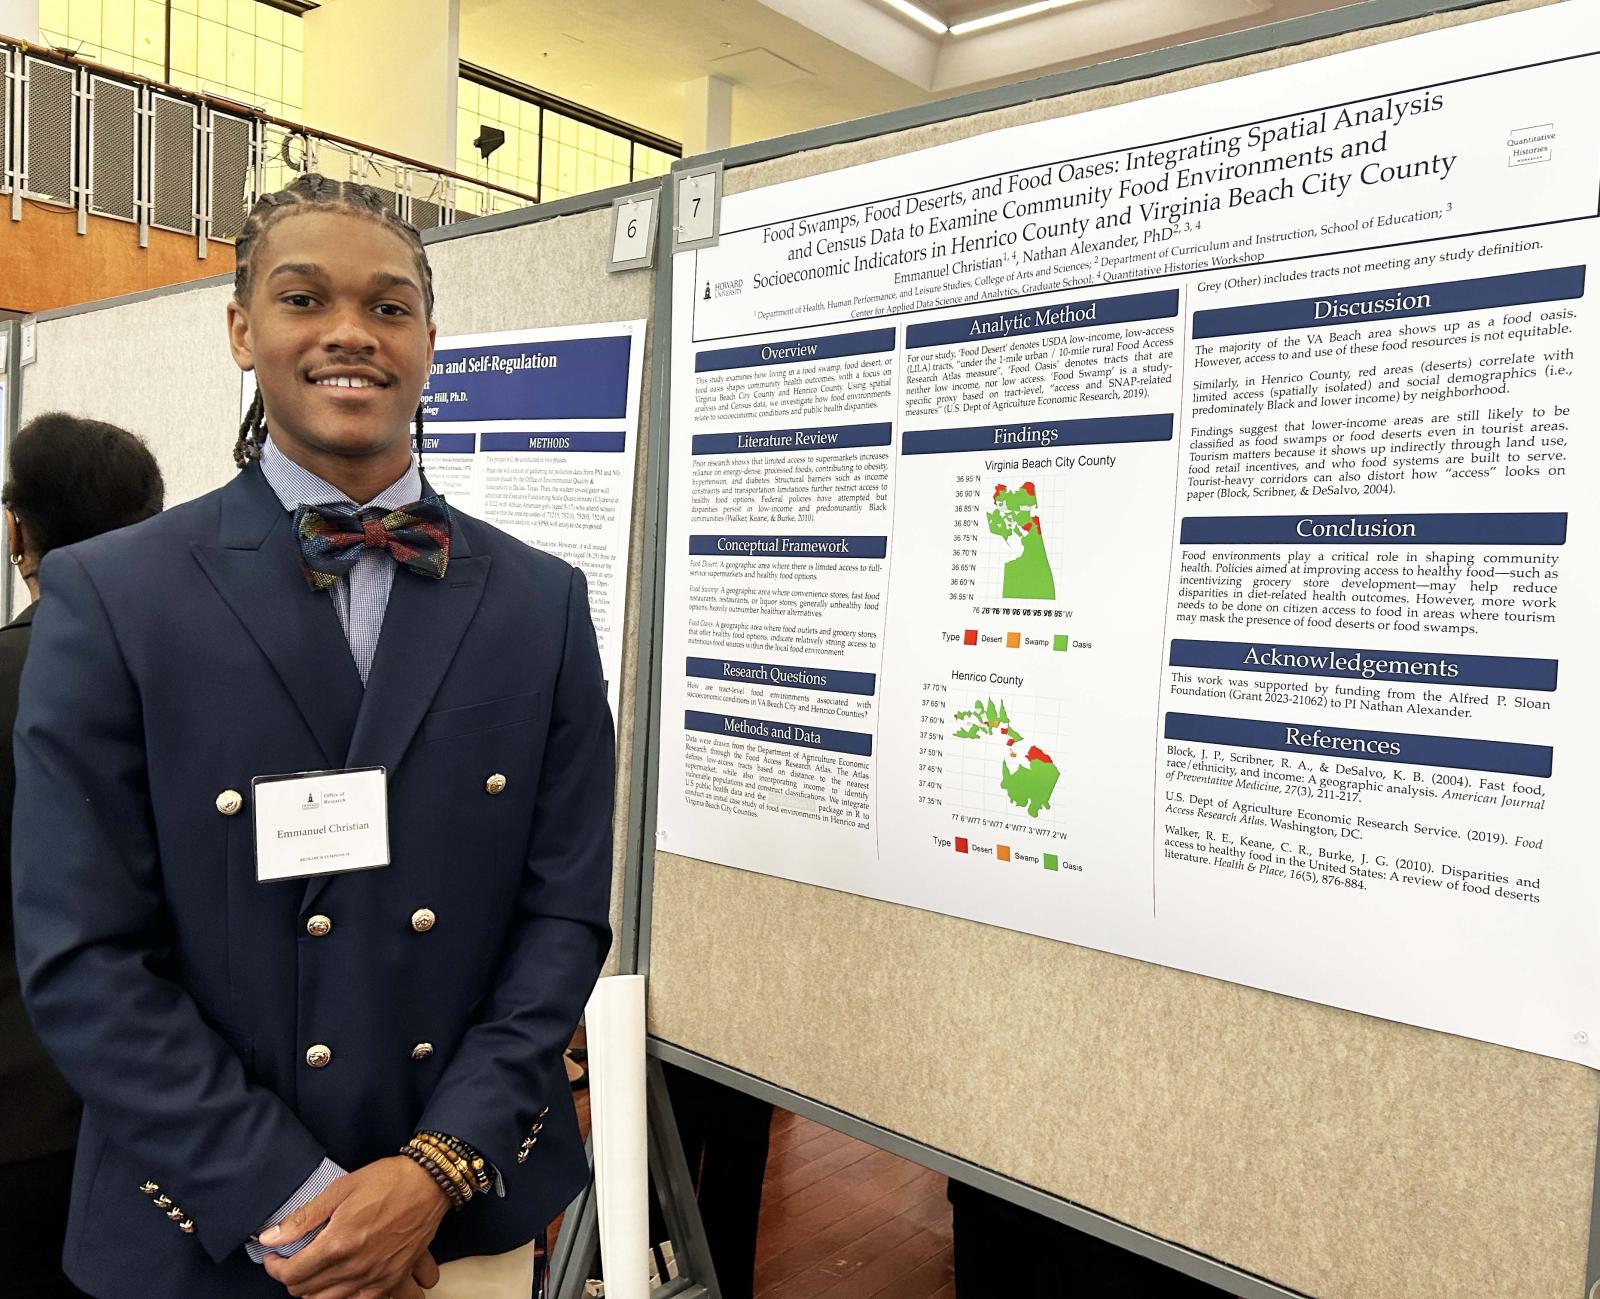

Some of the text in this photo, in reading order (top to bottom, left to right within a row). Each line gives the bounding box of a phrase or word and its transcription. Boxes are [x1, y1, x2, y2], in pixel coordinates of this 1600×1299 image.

[1506, 134, 1556, 146] Quantitative
[1514, 146, 1548, 157] Histories
[762, 92, 1443, 243] Food Swamps, Food Deserts, and Food Oases: Integrating Spatial Analysis
[787, 130, 1387, 260] and Census Data to Examine Community Food Environments and
[692, 198, 701, 218] 7
[627, 219, 637, 238] 6
[753, 154, 1457, 289] Socioeconomic Indicators in Henrico County and Virginia Beach City County
[894, 263, 949, 284] Emmanuel
[1022, 245, 1066, 263] Nathan
[1070, 234, 1138, 256] Alexander,
[1197, 240, 1543, 293] Grey (Other) includes tracts not meeting any study definition.
[714, 279, 743, 292] HOWARD
[1314, 294, 1431, 319] Discussion
[968, 304, 1096, 335] Analytic Method
[1194, 307, 1576, 355] The majority of the VA Beach area shows up as a food oasis.
[761, 343, 818, 360] Overview
[446, 358, 466, 373] and
[468, 353, 557, 376] Self-Regulation
[434, 393, 449, 403] Hill,
[450, 392, 468, 401] Ph.D.
[962, 403, 981, 413] Dept
[982, 400, 990, 410] of
[991, 398, 1036, 411] Agriculture
[1037, 393, 1077, 405] Economic
[1079, 390, 1120, 402] Research,
[1122, 387, 1149, 398] 2019).
[529, 438, 569, 449] METHODS
[737, 430, 838, 448] Literature Review
[993, 426, 1058, 445] Findings
[984, 455, 1116, 472] Virginia Beach City County
[1296, 518, 1416, 537] Conclusion
[717, 537, 848, 555] Conceptual Framework
[942, 632, 1092, 648] Type Desert Swamp Oasis
[722, 662, 826, 685] Research Questions
[1242, 648, 1458, 677] Acknowledgements
[951, 669, 1024, 688] Henrico County
[1170, 684, 1472, 717] Foundation (Grant 2023-21062) to PI Nathan Alexander.
[1171, 672, 1550, 710] This work was supported by funding from the Alfred P. Sloan
[686, 691, 722, 701] socioeconomic
[722, 695, 750, 704] conditions
[757, 698, 766, 707] VA
[766, 699, 783, 708] Beach
[784, 701, 796, 712] City
[797, 704, 810, 712] and
[810, 704, 835, 715] Henrico
[836, 707, 868, 718] Counties?
[724, 717, 820, 743] Methods and Data
[1284, 728, 1400, 755] References
[277, 822, 369, 838] Emmanuel Christian
[933, 836, 1082, 872] Type Desert Swamp Oasis
[1164, 848, 1366, 890] literature. Health & Place, 16(5), 876-884.
